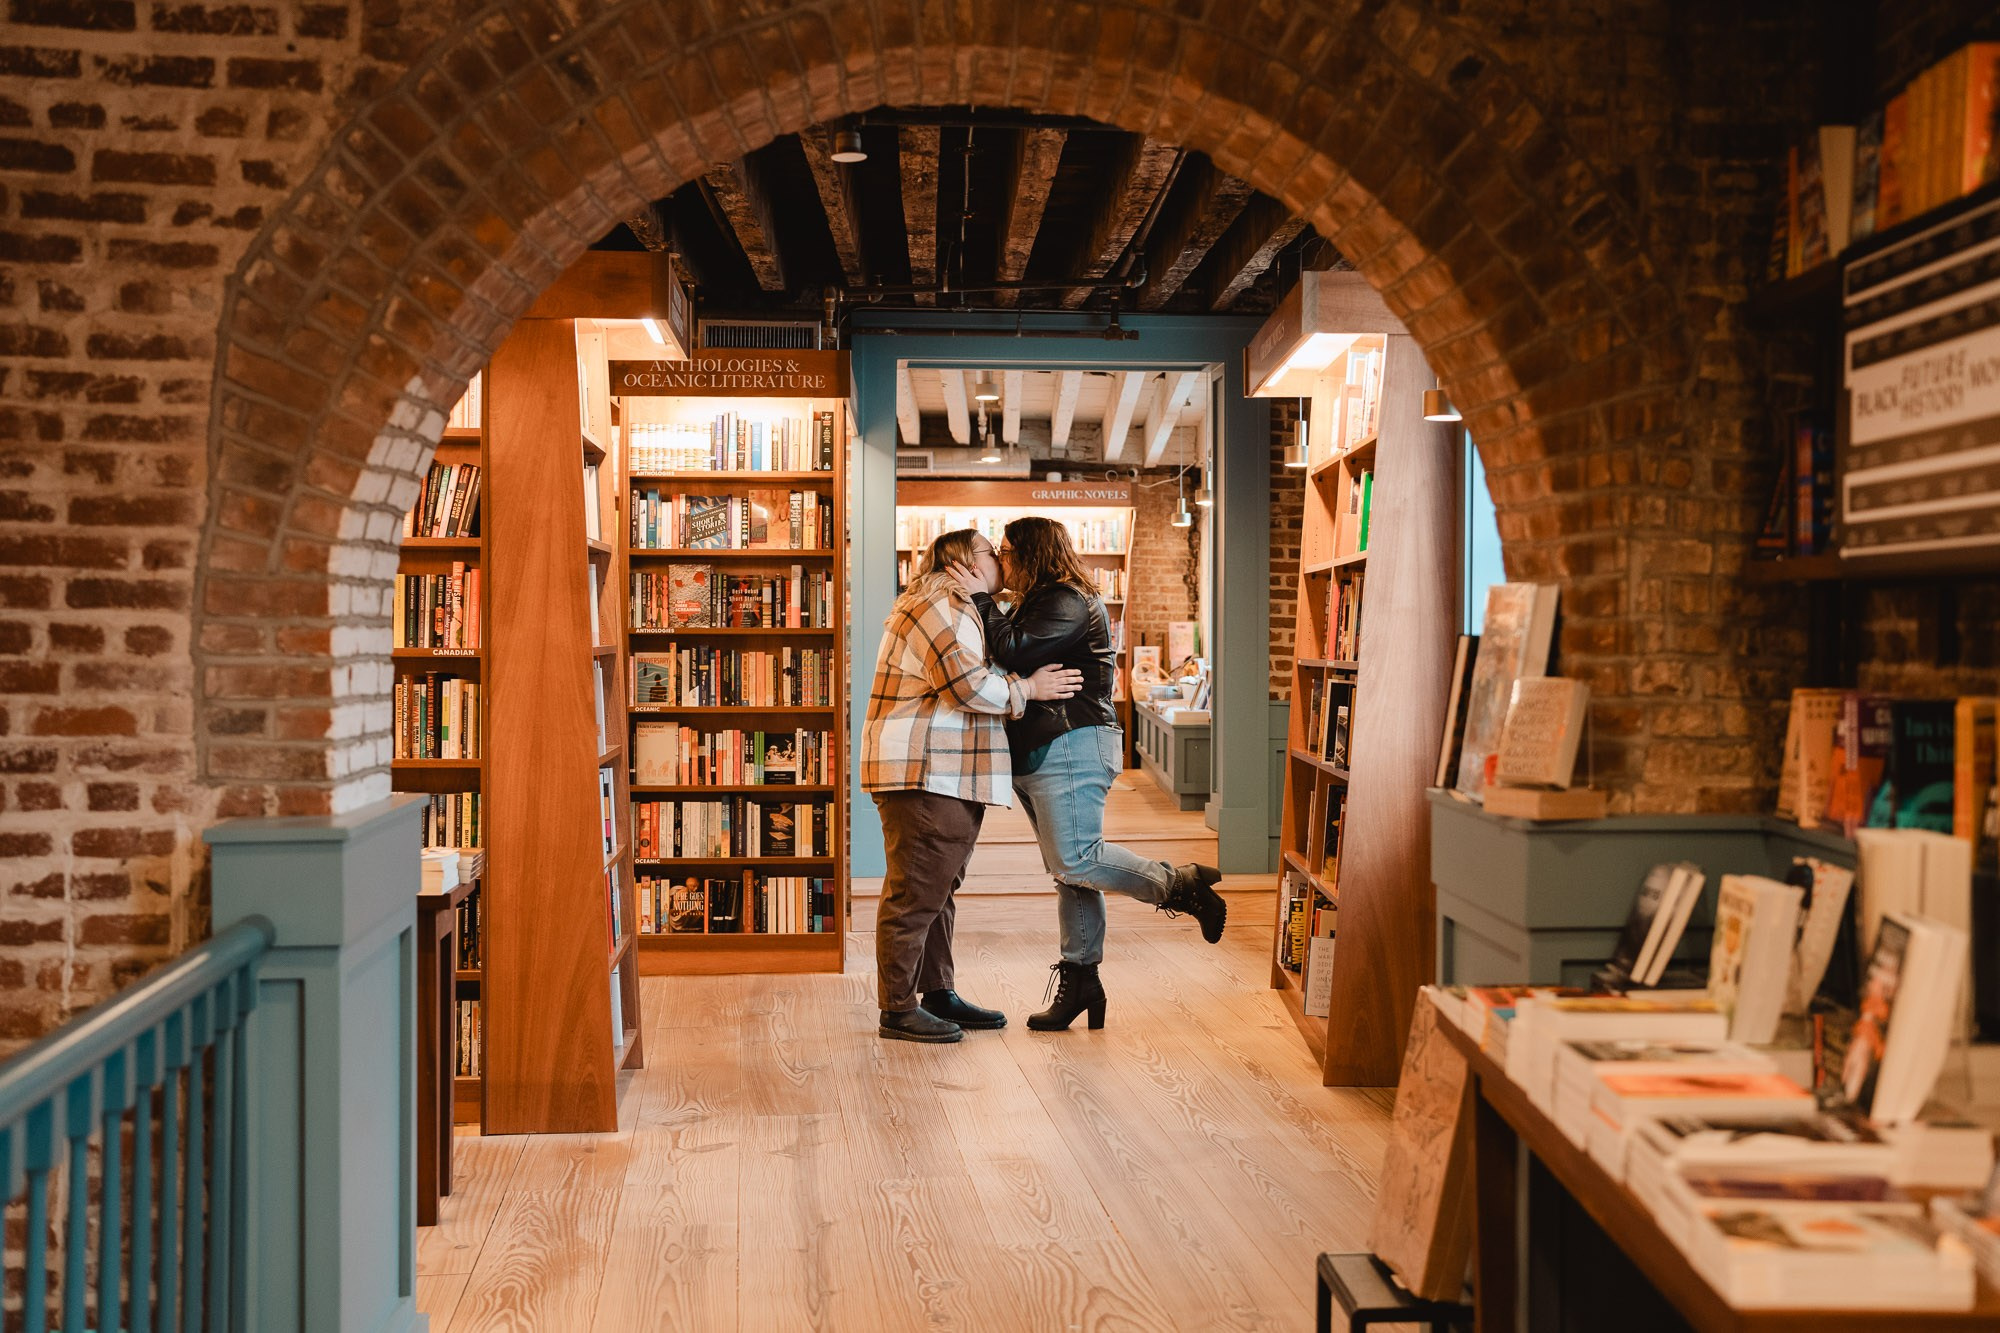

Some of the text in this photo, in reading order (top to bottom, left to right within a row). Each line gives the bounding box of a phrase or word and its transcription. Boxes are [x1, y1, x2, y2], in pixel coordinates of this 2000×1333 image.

[649, 358, 801, 373] ANTHOLOGIES &
[623, 373, 826, 389] OCEANIC LITERATURE
[1032, 490, 1129, 500] GRAPHIC NOVELS
[691, 516, 715, 529] SHORT
[696, 517, 727, 533] STORIES
[454, 565, 462, 577] THE
[673, 891, 704, 901] HERE GOES
[672, 900, 704, 911] NOTHING
[1291, 911, 1305, 965] WATCHMEN
